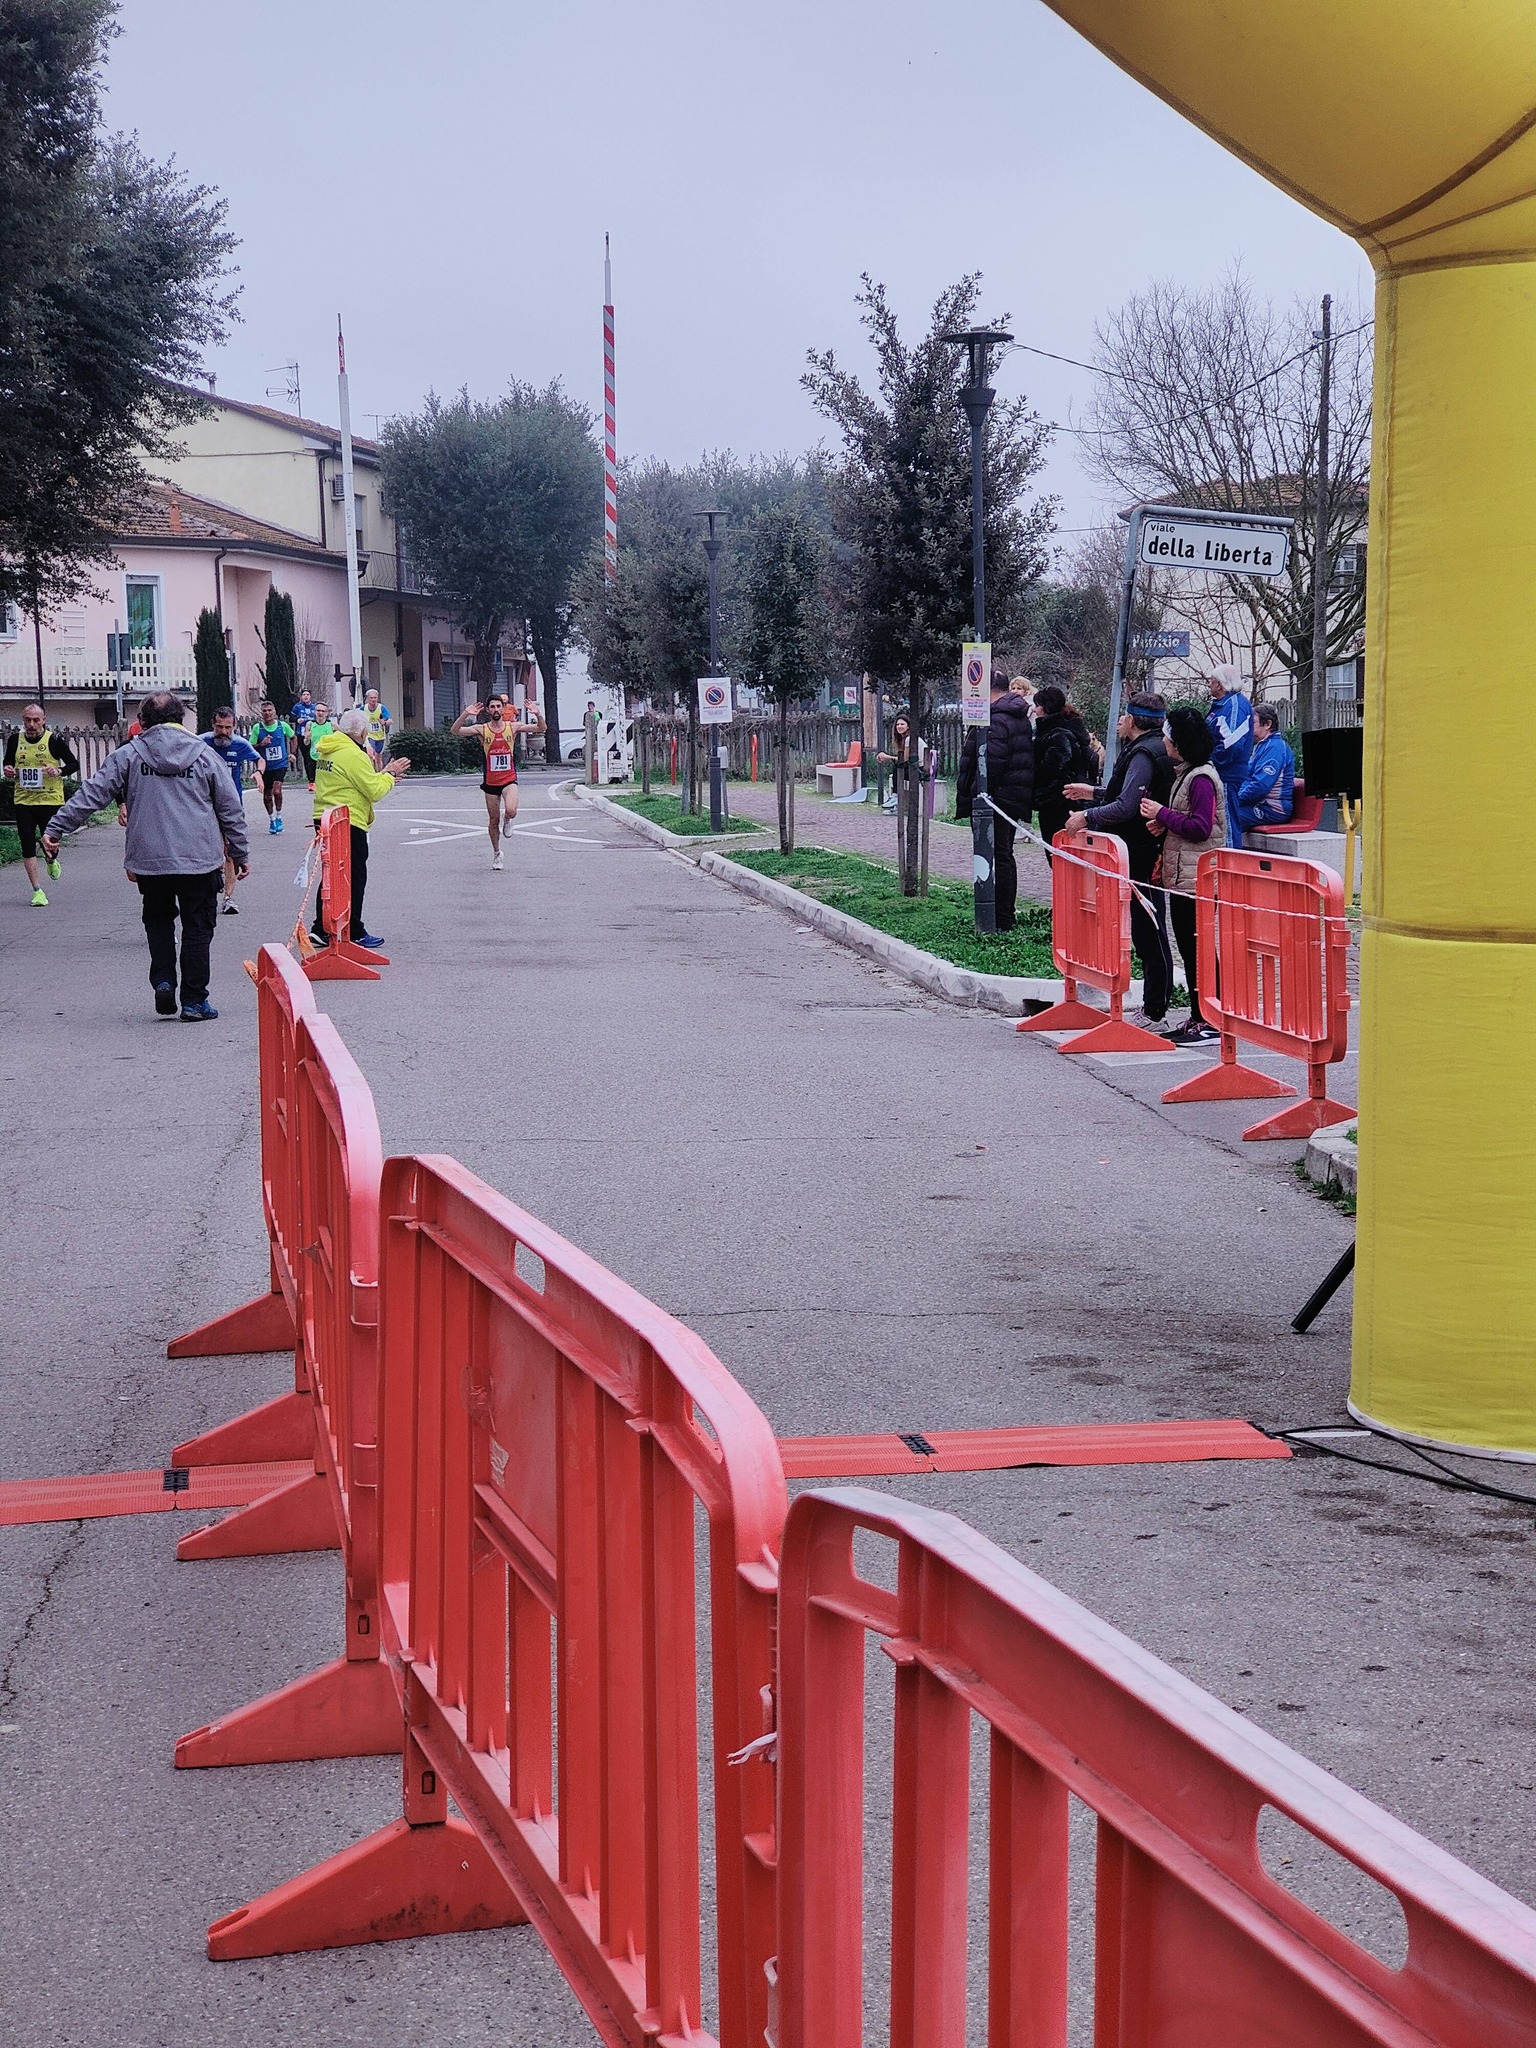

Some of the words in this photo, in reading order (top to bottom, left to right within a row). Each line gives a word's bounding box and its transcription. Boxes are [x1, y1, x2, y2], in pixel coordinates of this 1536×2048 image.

[1150, 523, 1176, 533] viale
[1148, 535, 1195, 559] della
[495, 755, 508, 766] 781
[22, 768, 39, 781] 686
